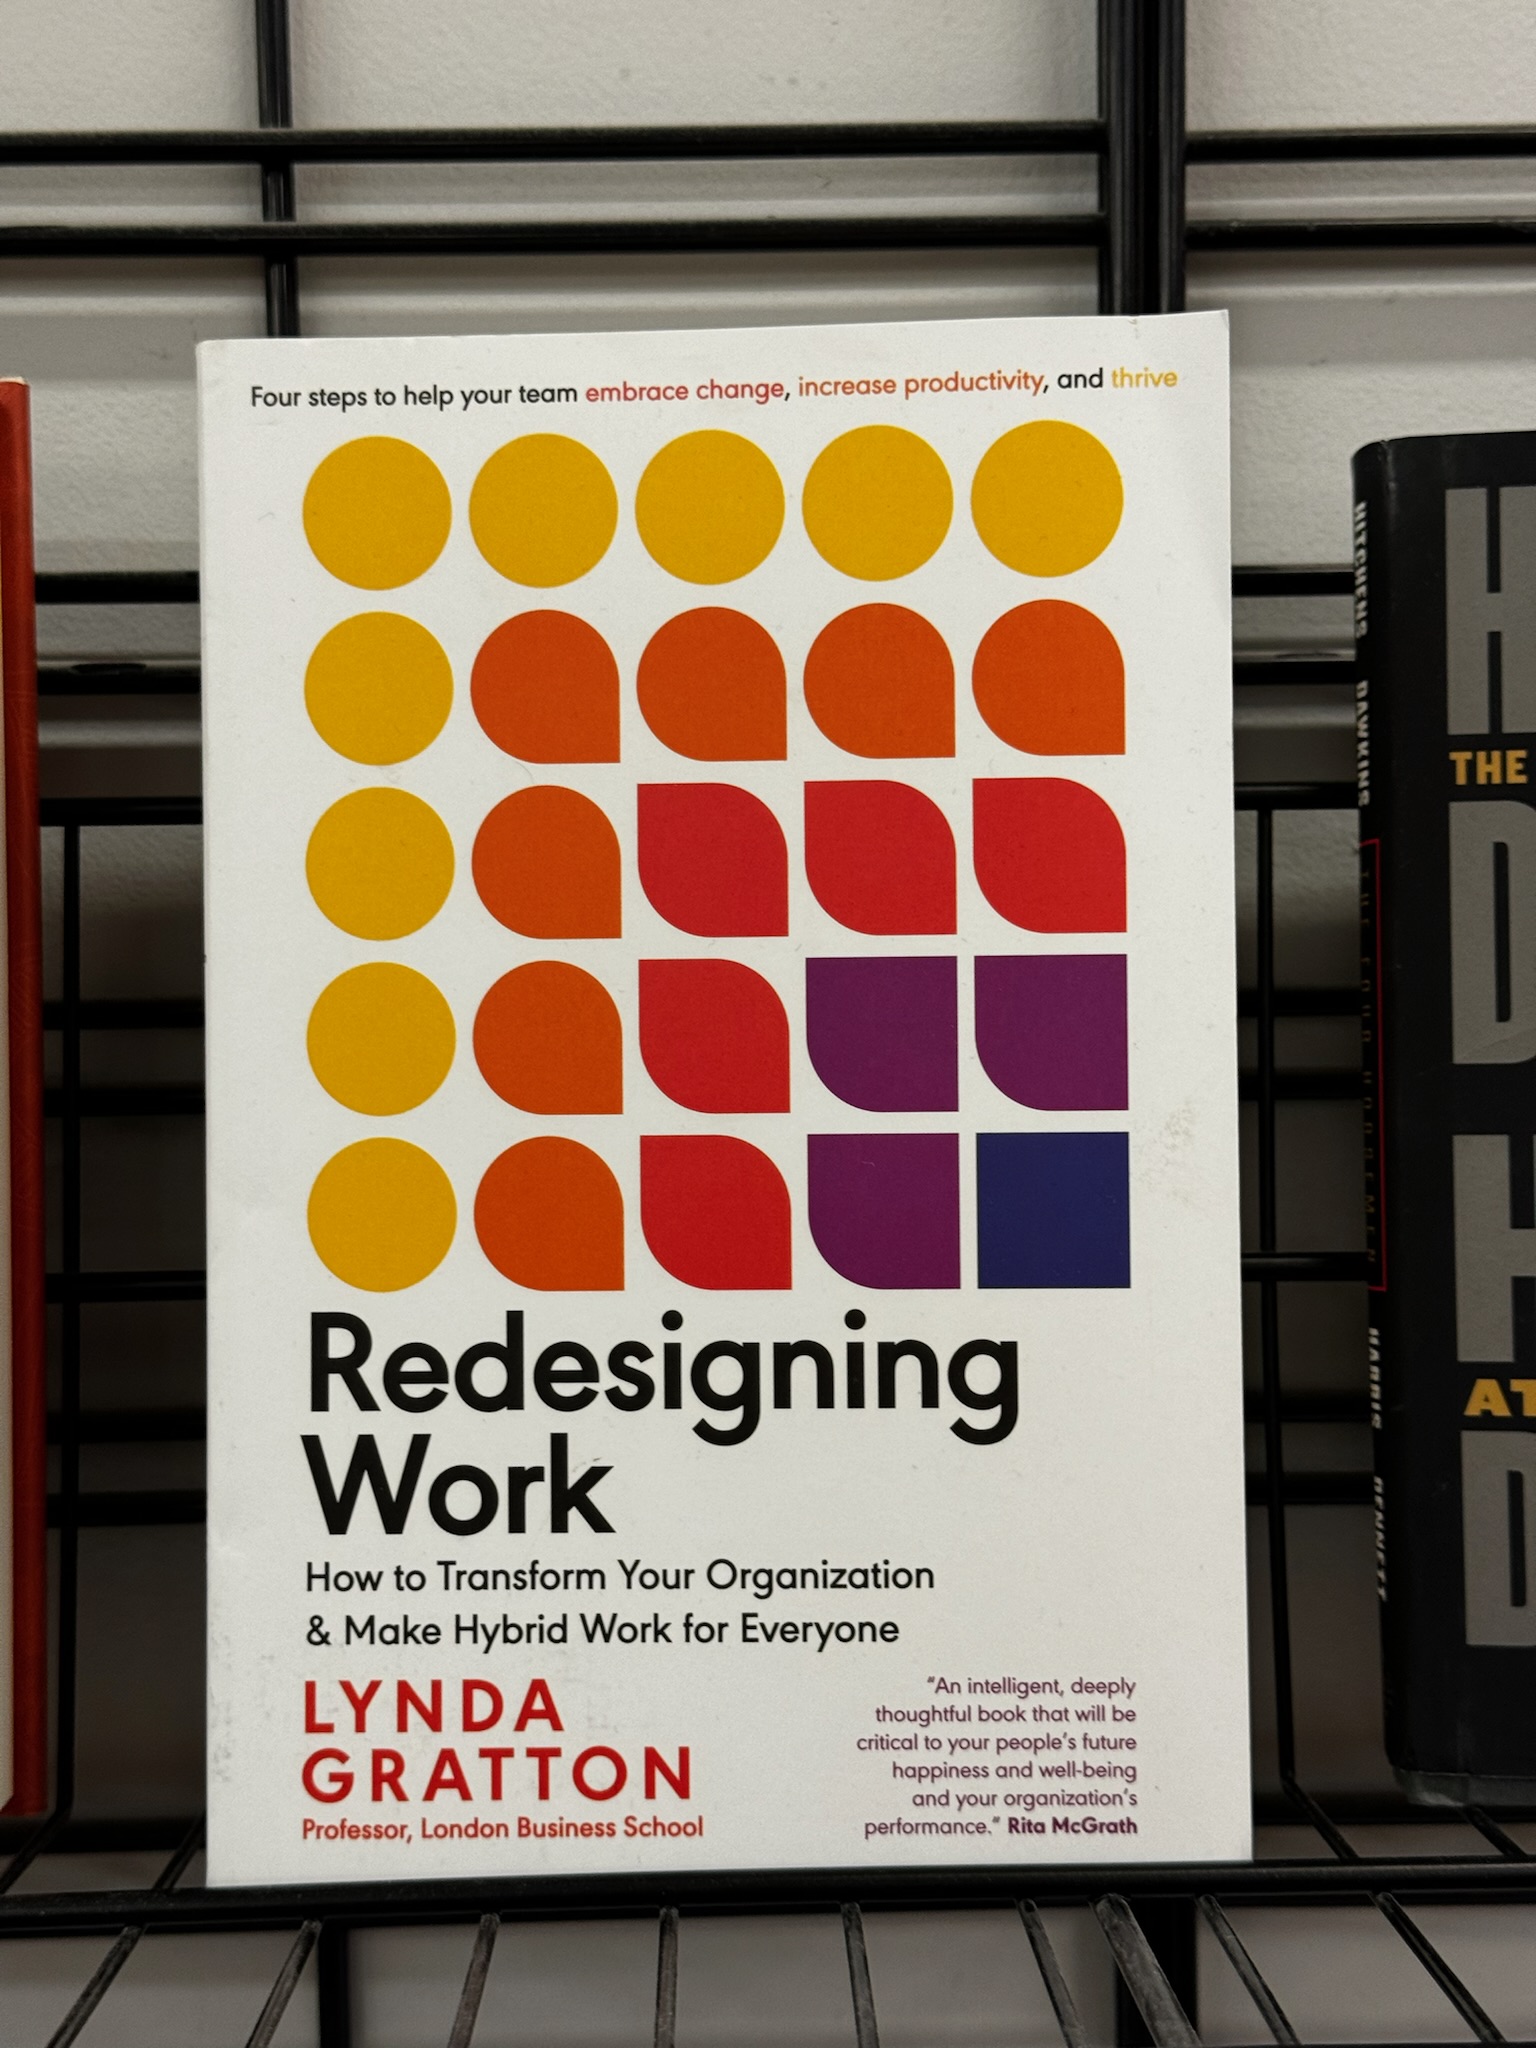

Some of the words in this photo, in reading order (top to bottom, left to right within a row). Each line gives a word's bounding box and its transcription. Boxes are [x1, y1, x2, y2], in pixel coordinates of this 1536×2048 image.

[251, 386, 302, 407] Four
[308, 389, 367, 413] steps
[374, 388, 396, 406] to
[404, 384, 454, 411] help
[460, 389, 512, 411] your
[518, 386, 577, 403] team
[585, 381, 689, 402] embrace
[696, 379, 790, 405] change,
[799, 376, 897, 396] increase
[905, 369, 1049, 400] productivity,
[1057, 367, 1103, 389] and
[1112, 367, 1178, 388] thrive
[1356, 679, 1370, 807] DAWKINS
[1449, 750, 1528, 785] THE
[310, 1309, 1019, 1446] Redesigning
[300, 1433, 616, 1536] Work
[307, 1562, 384, 1592] How
[393, 1565, 426, 1592] to
[436, 1560, 606, 1591] Transform
[617, 1559, 695, 1590] Your
[706, 1559, 934, 1600] Organization
[306, 1615, 332, 1646] &
[345, 1614, 442, 1645] Make
[455, 1613, 568, 1654] Hybrid
[579, 1613, 672, 1644] Work
[683, 1612, 729, 1643] for
[742, 1612, 899, 1653] Everyone
[304, 1678, 564, 1734] LYNDA
[927, 1676, 961, 1694] “An
[968, 1677, 1064, 1699] intelligent,
[1071, 1677, 1136, 1699] deeply
[875, 1705, 971, 1728] thoughtful
[978, 1705, 1026, 1722] book
[1032, 1705, 1069, 1722] that
[1075, 1705, 1105, 1721] will
[1112, 1705, 1136, 1722] be
[857, 1733, 918, 1751] critical
[924, 1736, 942, 1750] to
[948, 1738, 990, 1755] your
[996, 1732, 1076, 1755] people’s
[1082, 1733, 1137, 1750] future
[301, 1745, 690, 1804] GRATTON
[893, 1761, 989, 1783] happiness
[995, 1761, 1032, 1778] and
[1039, 1761, 1137, 1784] well-being
[912, 1789, 949, 1806] and
[956, 1794, 997, 1811] your
[1004, 1788, 1137, 1812] organization’s
[303, 1818, 412, 1844] Professor,
[421, 1817, 509, 1839] London
[518, 1816, 616, 1838] Business
[624, 1815, 703, 1838] School
[865, 1816, 1000, 1840] performance.”
[1008, 1817, 1046, 1834] Rita
[1052, 1816, 1138, 1834] McGrath
